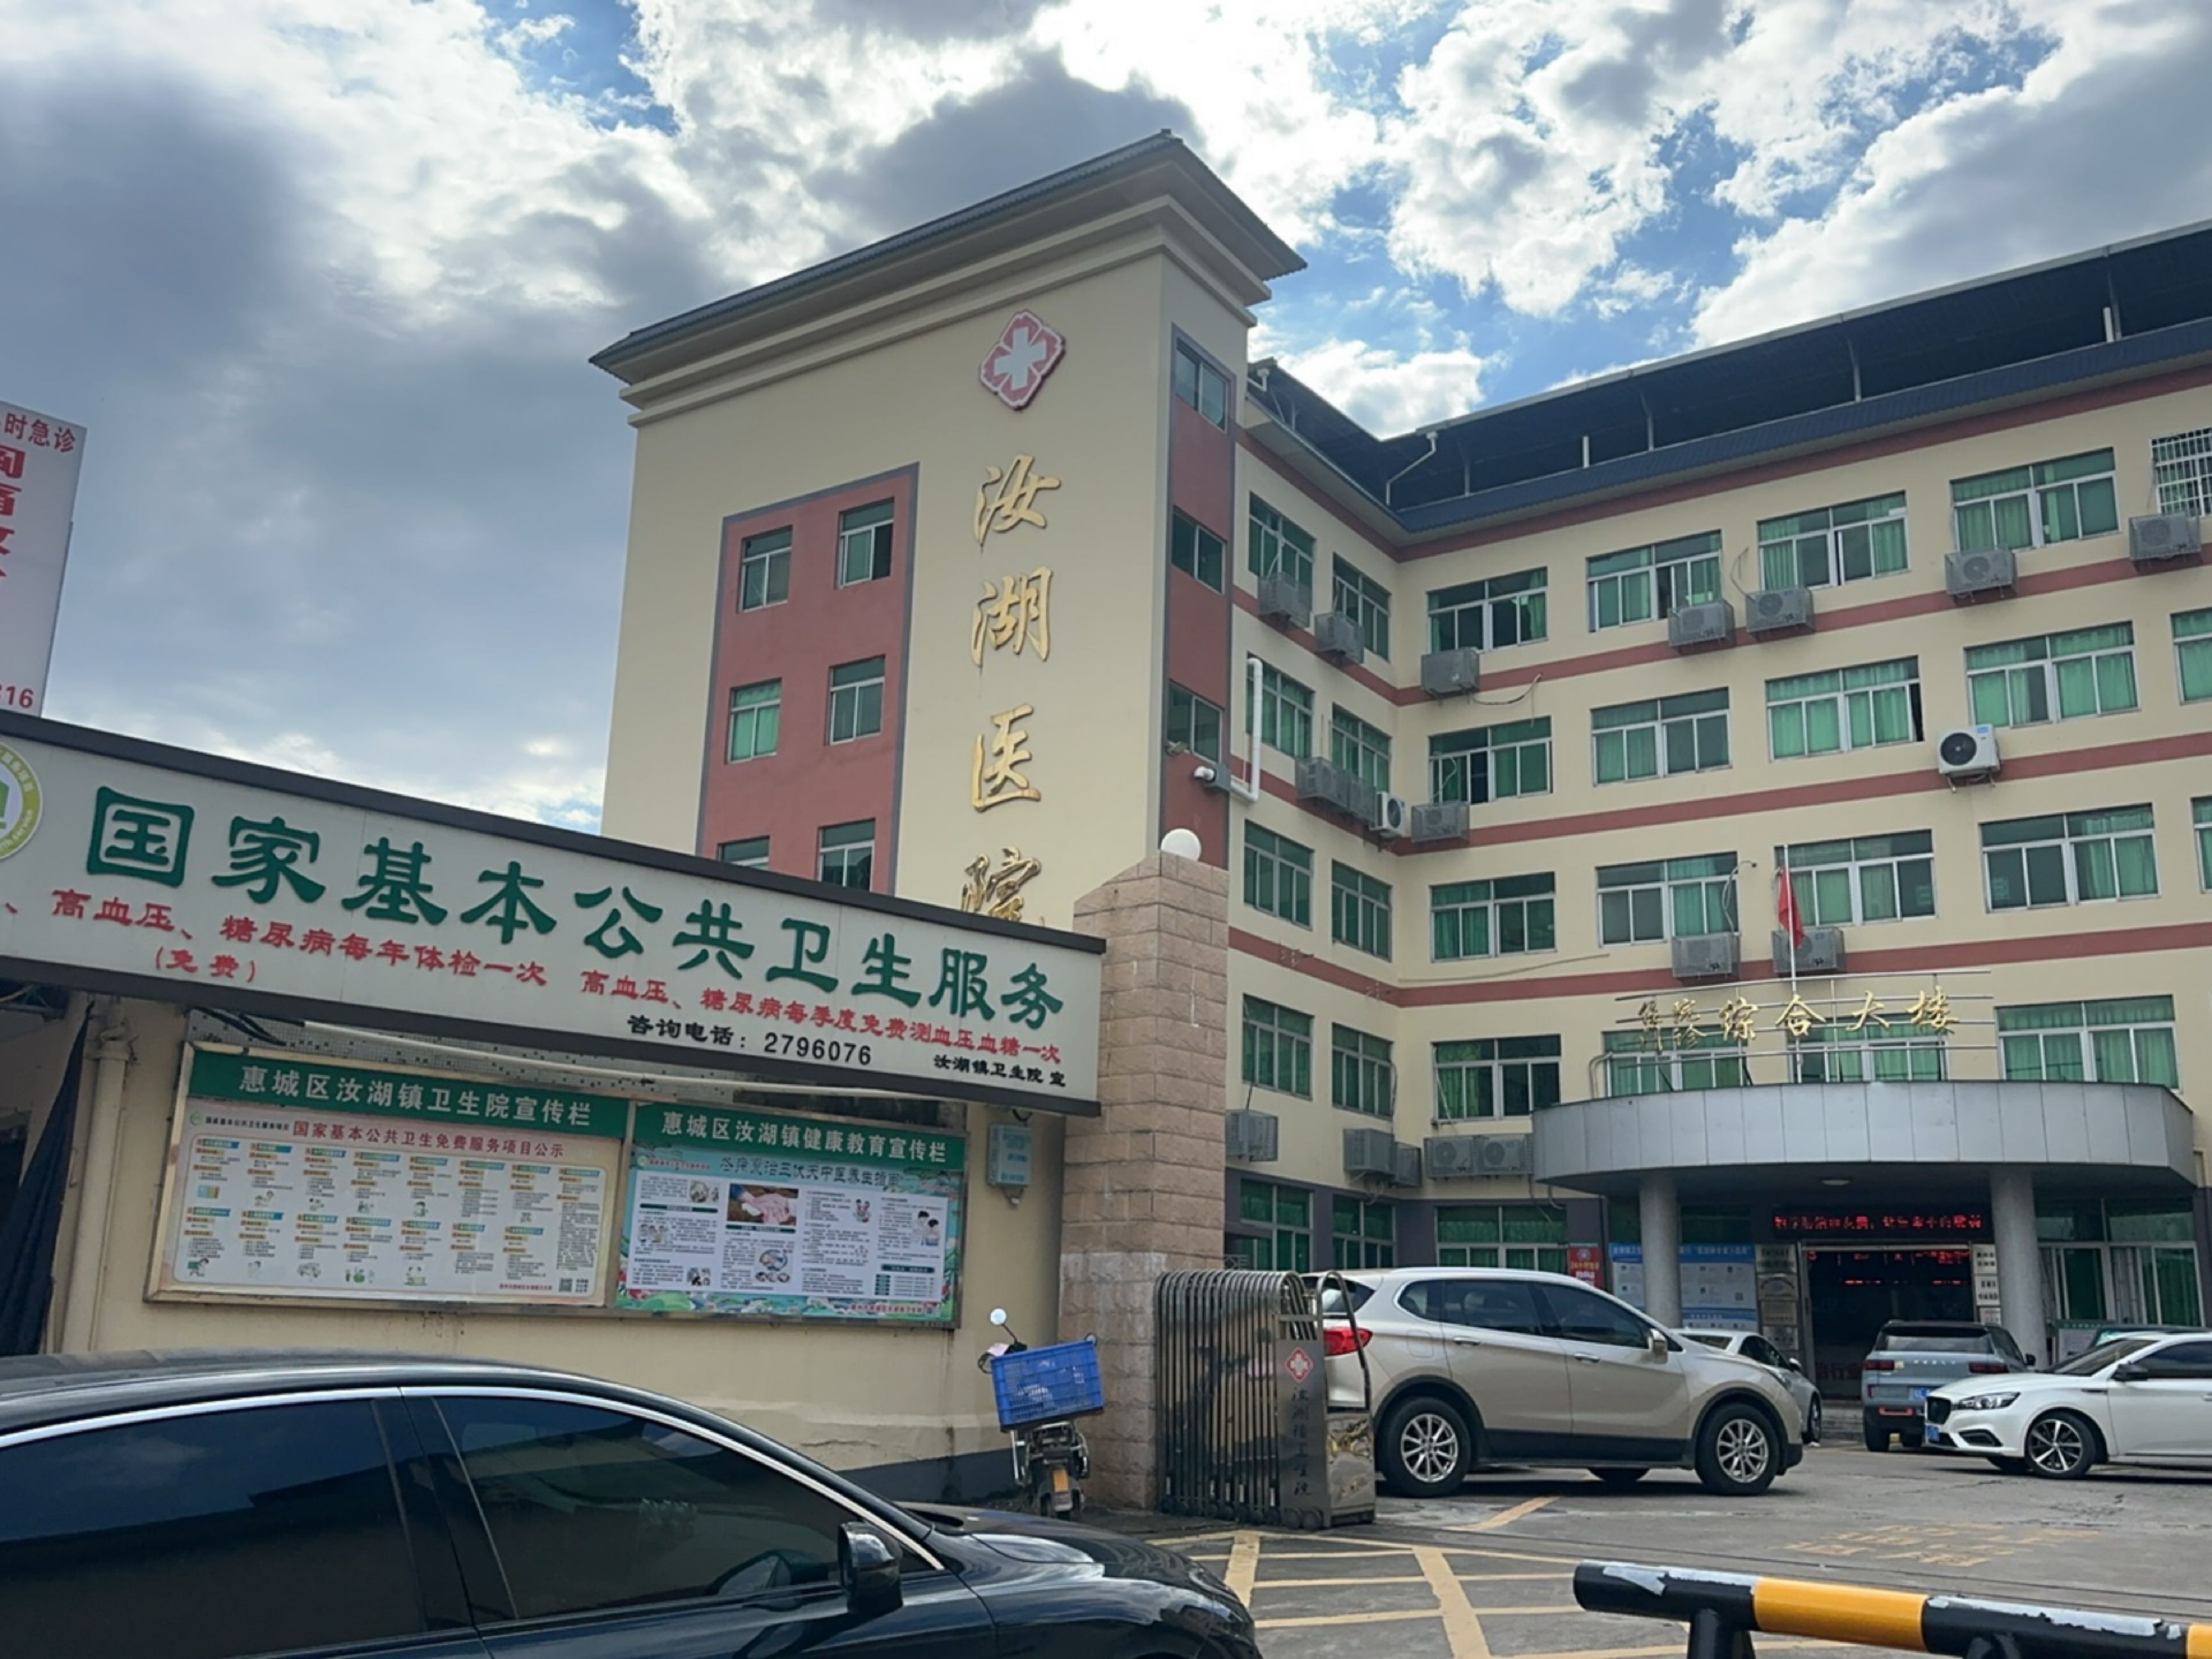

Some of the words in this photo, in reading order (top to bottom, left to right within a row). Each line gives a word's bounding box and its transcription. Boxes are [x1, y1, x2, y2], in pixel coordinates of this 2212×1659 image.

[0, 412, 76, 453] 时急诊
[0, 683, 34, 709] 16
[961, 454, 1062, 920] 汝湖医院
[86, 785, 1063, 1030] 国家基本公共卫生服务
[239, 1066, 591, 1126] 惠城区汝湖镇卫生院宣传栏
[662, 1110, 946, 1162] 惠城区汝湖镇健康教育宣传栏
